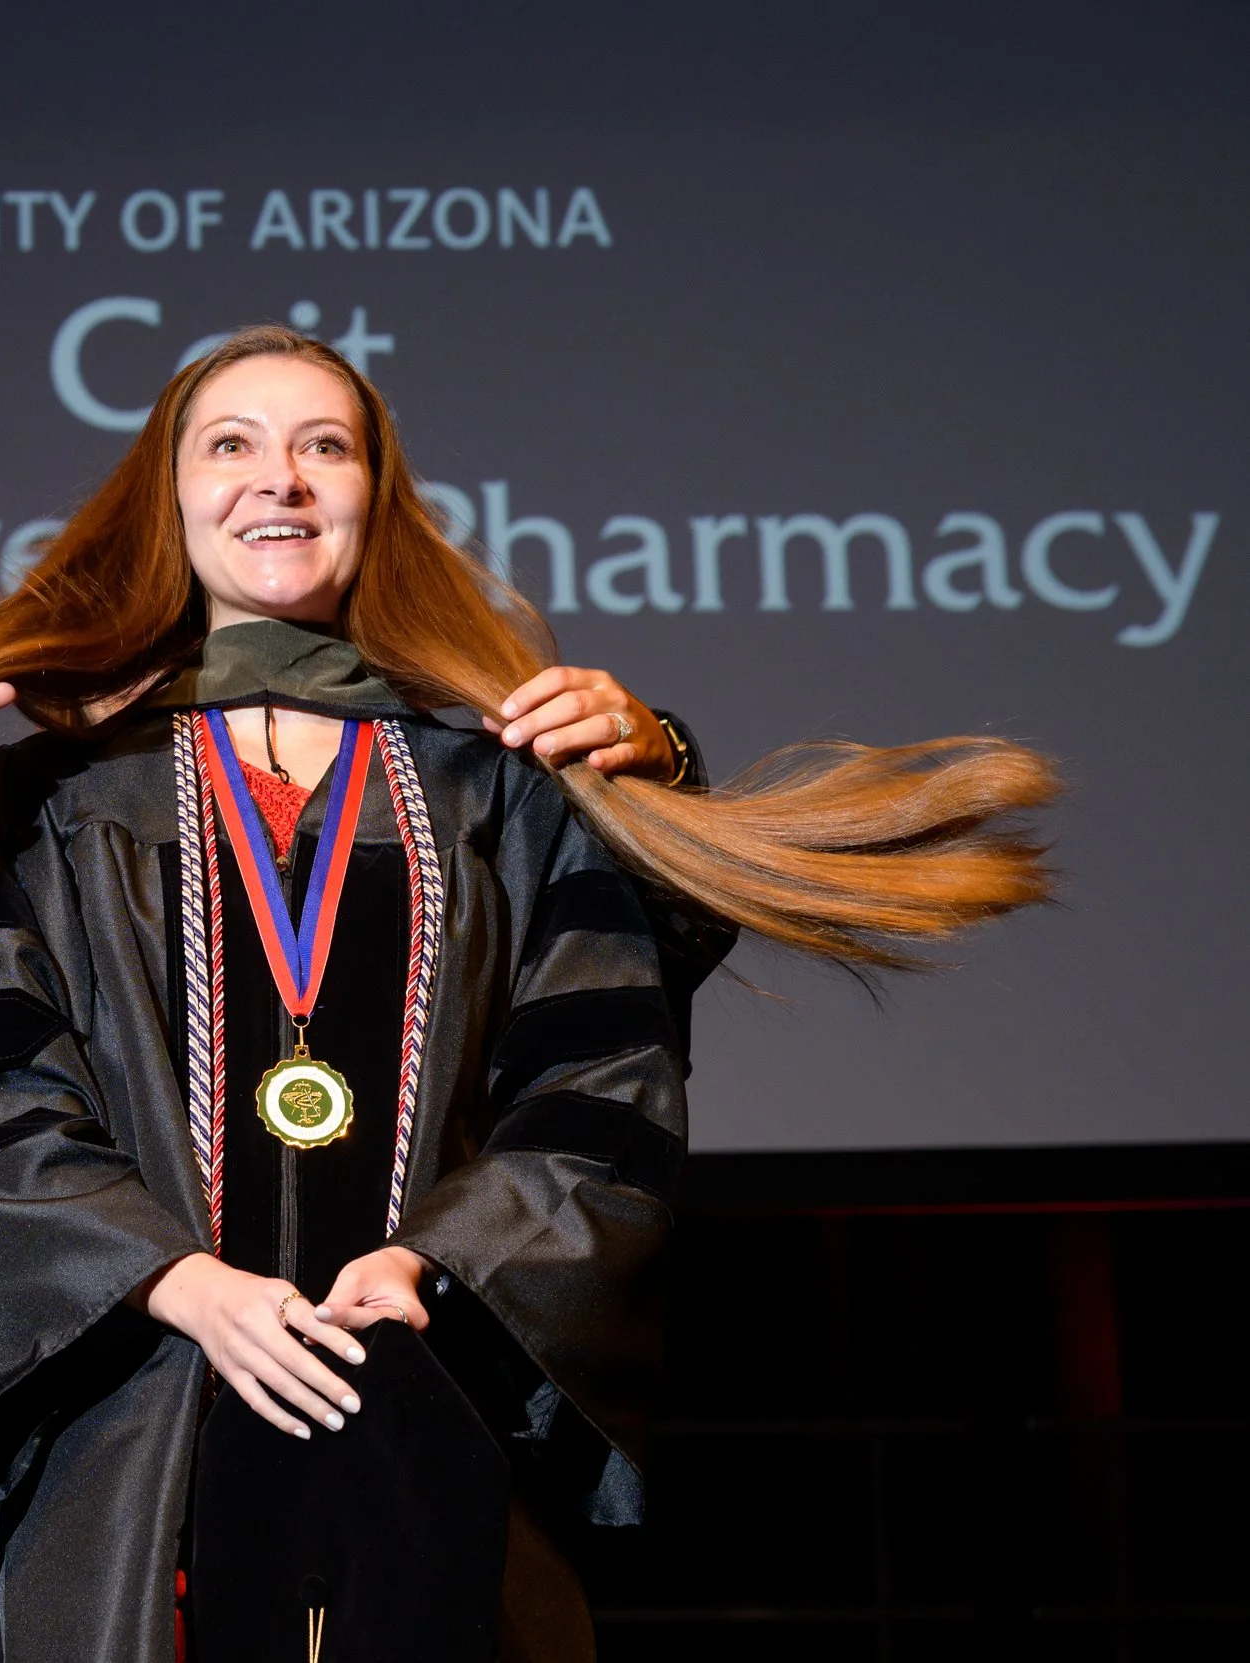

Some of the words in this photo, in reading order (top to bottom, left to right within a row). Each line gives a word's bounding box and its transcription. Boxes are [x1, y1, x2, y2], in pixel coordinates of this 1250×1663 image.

[120, 189, 225, 252] OF
[252, 187, 613, 250] ARIZONA
[50, 296, 396, 432] Ct
